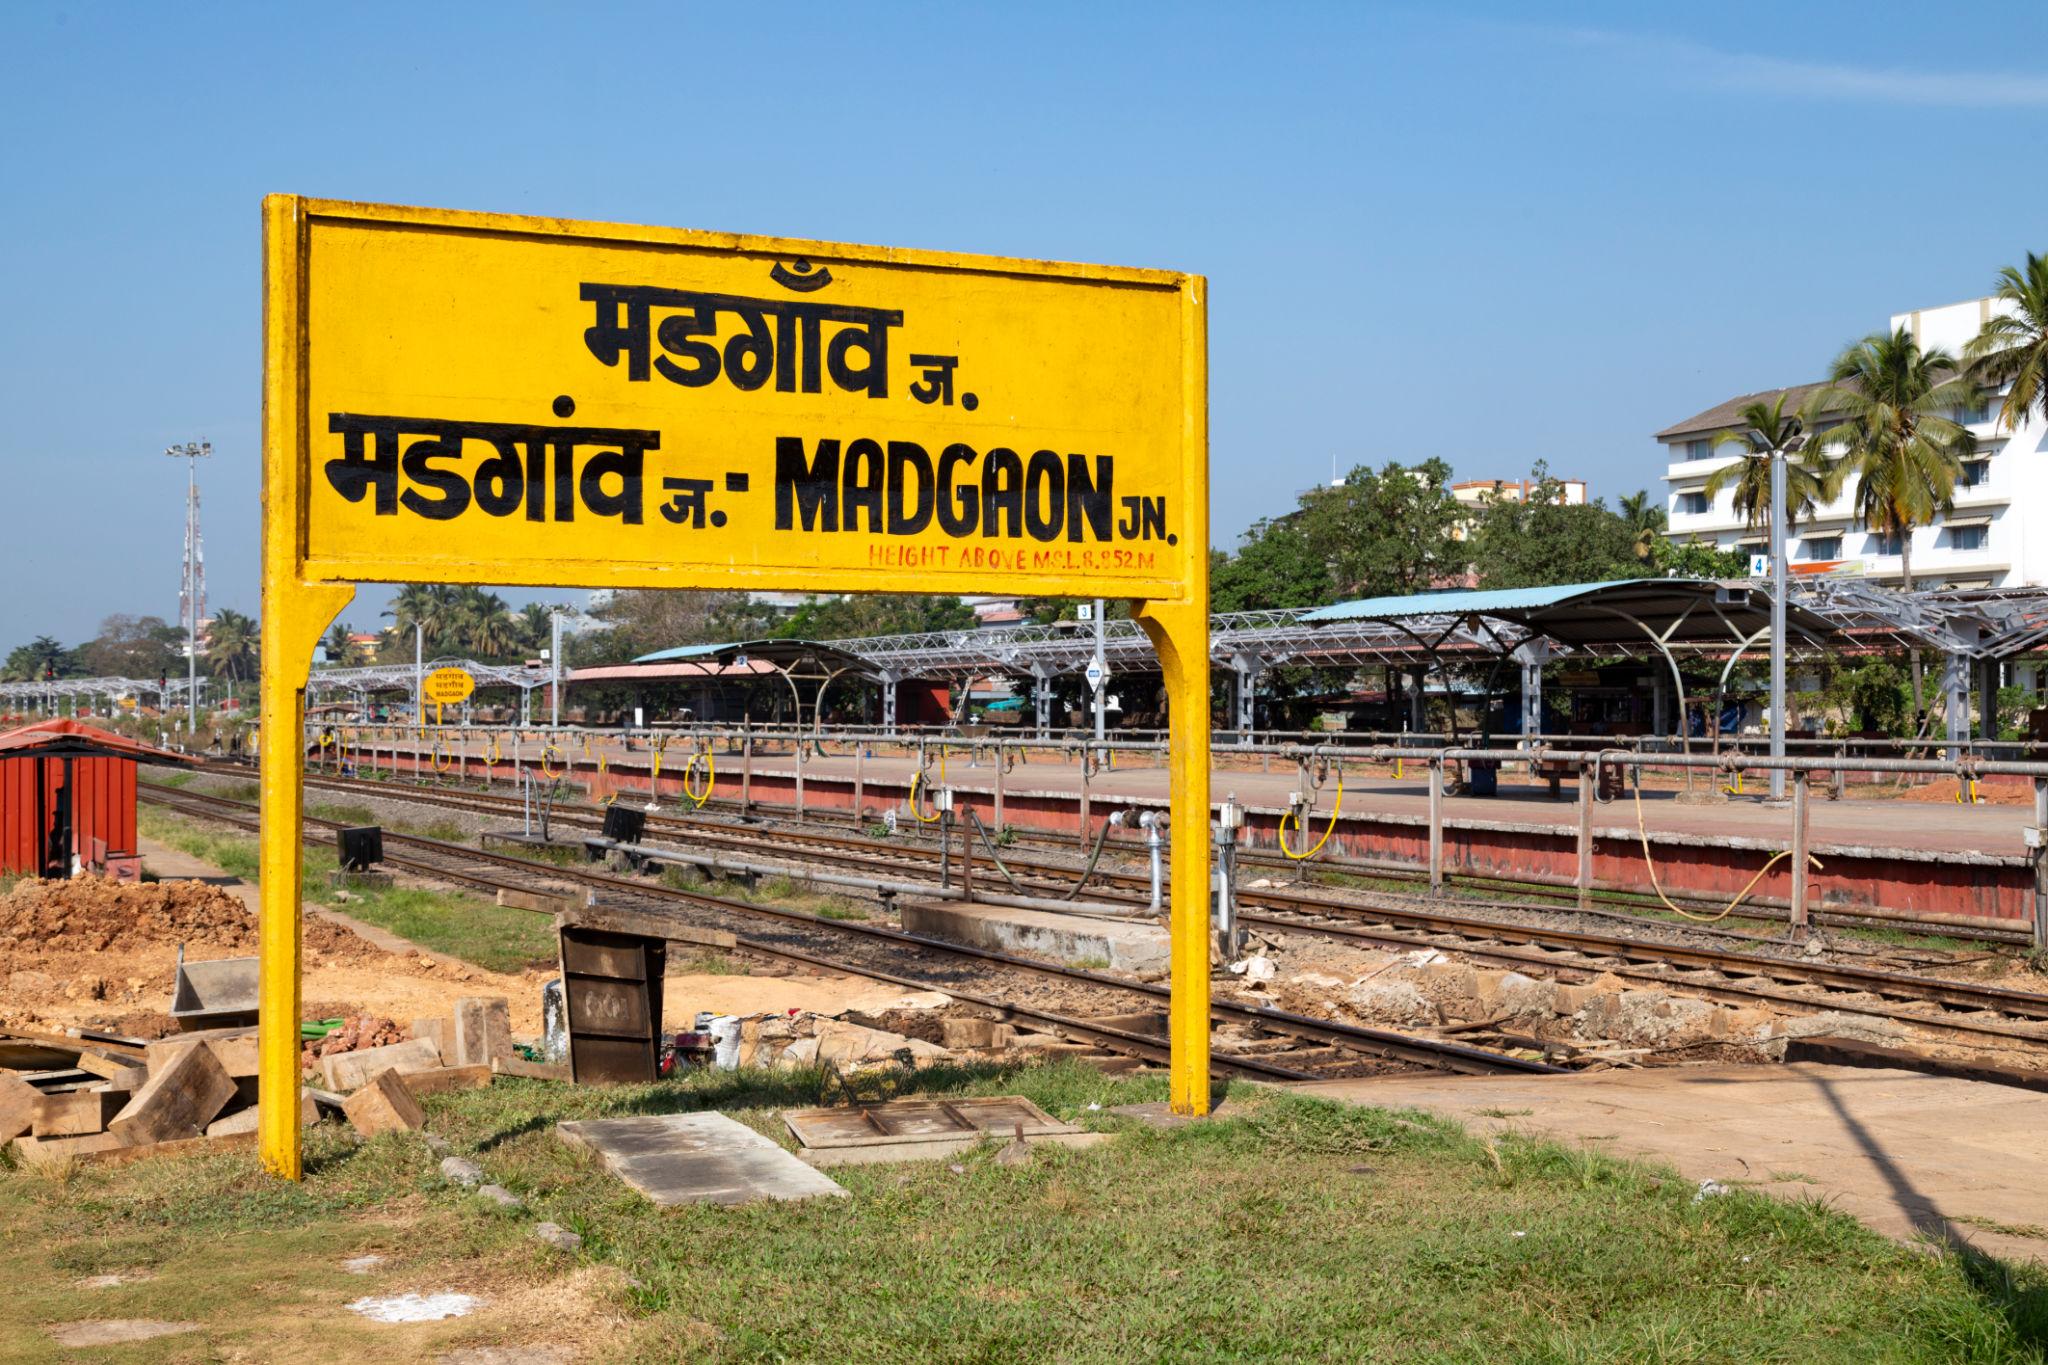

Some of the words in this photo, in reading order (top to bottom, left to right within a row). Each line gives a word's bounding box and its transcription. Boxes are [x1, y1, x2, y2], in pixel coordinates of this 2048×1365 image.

[579, 258, 904, 399] मडगाँव
[909, 353, 979, 412] ज.
[324, 395, 661, 525] मडगांव
[774, 436, 1115, 544] MADGAON
[1118, 495, 1179, 547] JN.
[868, 544, 950, 568] HEIGHT
[958, 546, 1027, 571] ABOVE
[1755, 558, 1763, 573] 4
[1081, 606, 1088, 618] 3
